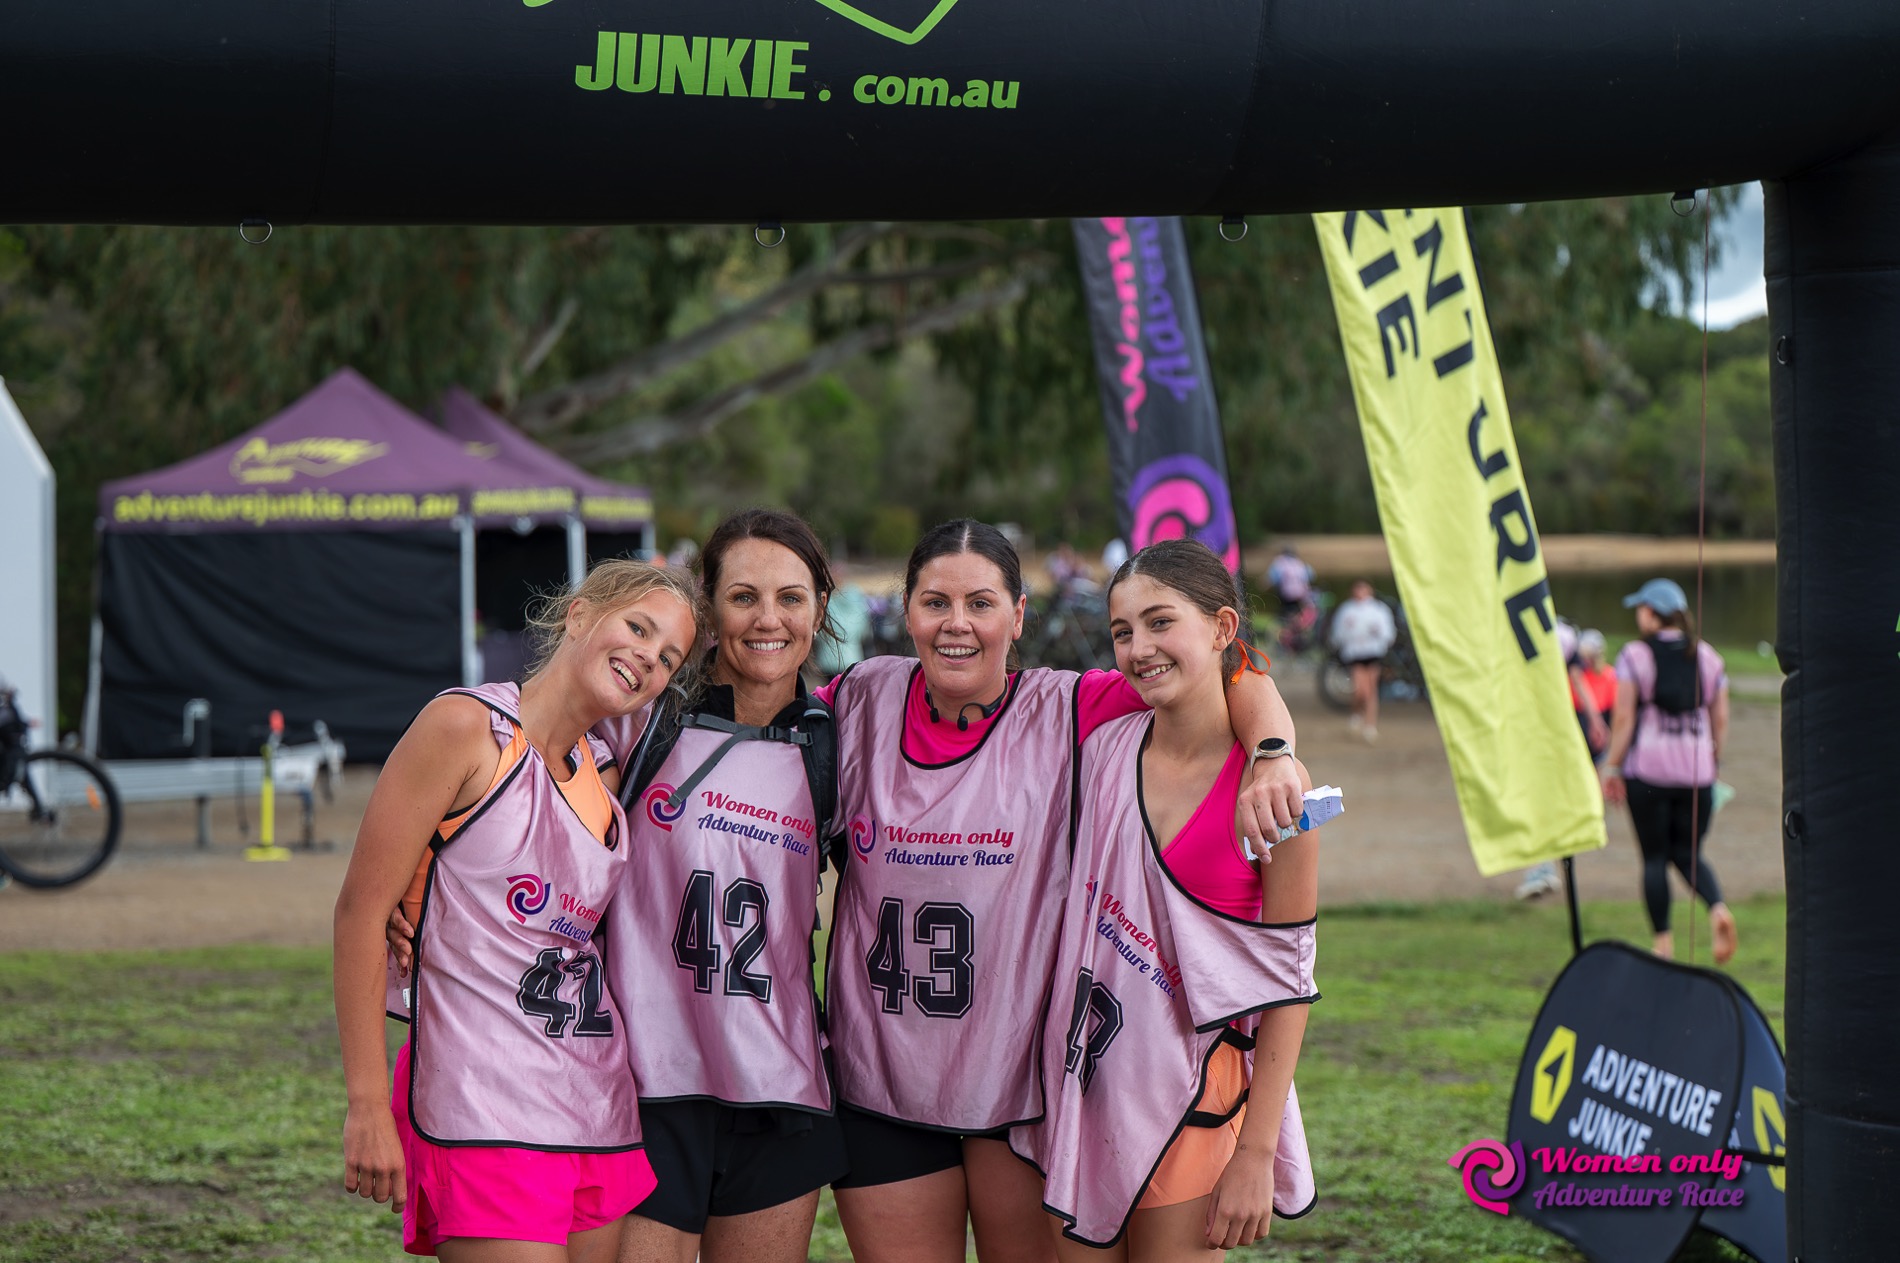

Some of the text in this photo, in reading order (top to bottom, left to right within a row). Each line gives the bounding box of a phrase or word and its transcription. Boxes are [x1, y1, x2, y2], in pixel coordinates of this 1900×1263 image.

[113, 488, 459, 526] adventurejunkie.com.au
[697, 813, 810, 856] Adventure Race
[701, 791, 815, 839] Women only
[884, 826, 1014, 848] Women only
[884, 848, 1015, 866] Adventure Race
[671, 869, 772, 1004] 42
[1102, 893, 1157, 953] Women
[866, 896, 975, 1020] 43
[516, 946, 614, 1038] 42
[1581, 1043, 1722, 1137] ADVENTURE
[1568, 1097, 1653, 1164] JUNKIE
